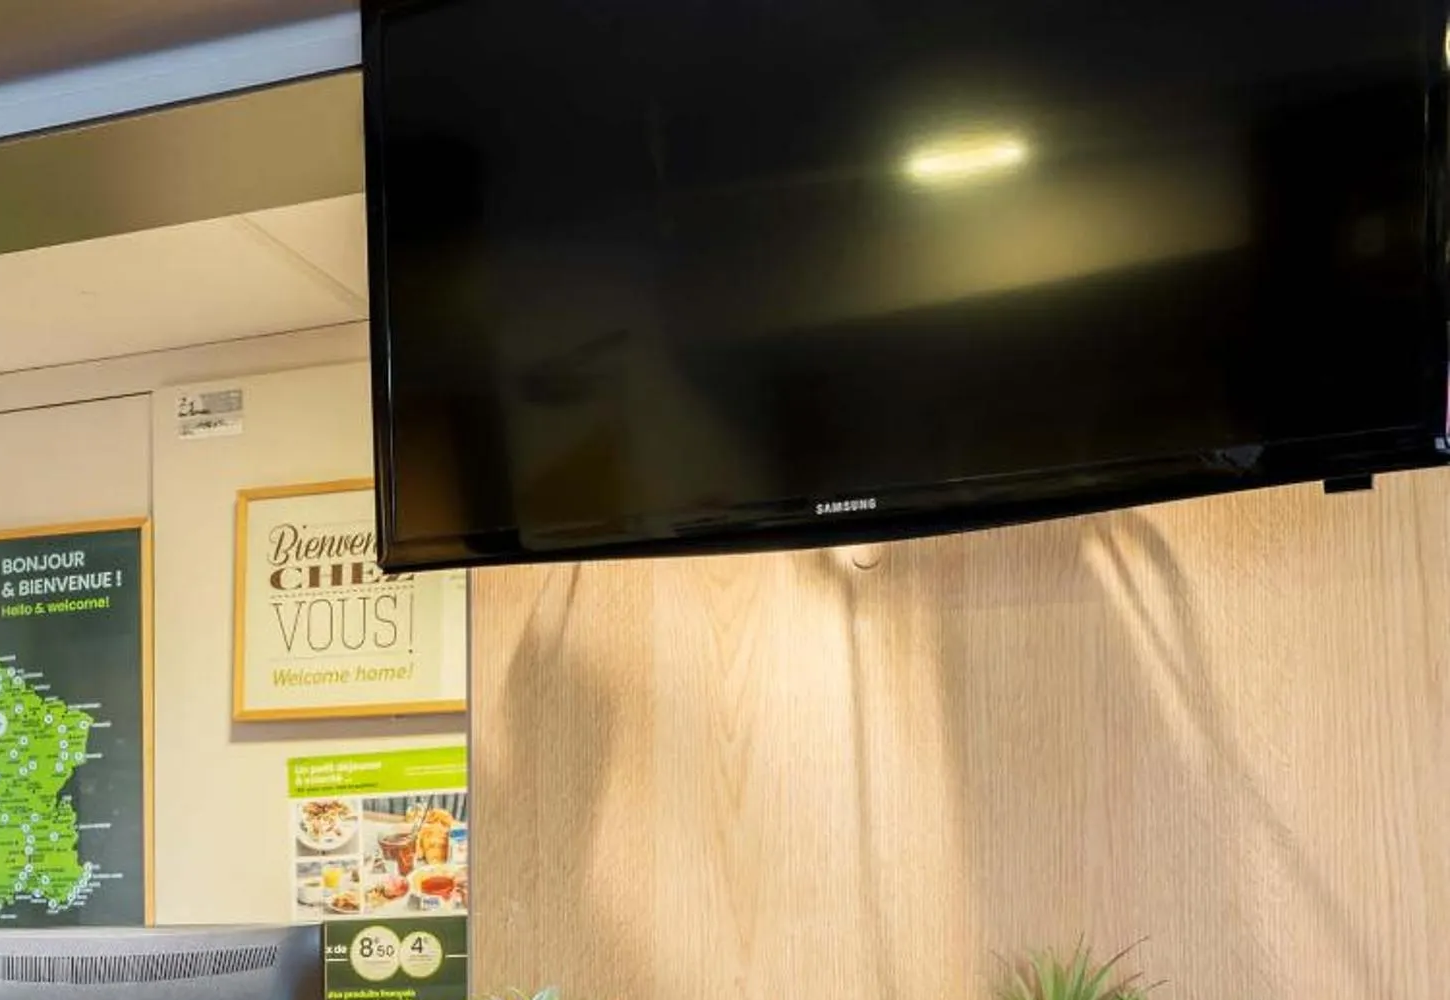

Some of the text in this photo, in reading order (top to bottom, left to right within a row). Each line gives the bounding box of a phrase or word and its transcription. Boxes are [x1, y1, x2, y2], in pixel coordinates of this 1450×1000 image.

[815, 498, 876, 515] SAMSUNG
[267, 523, 376, 566] Bienven
[1, 550, 85, 575] BONJOUR
[1, 581, 15, 598] &
[18, 572, 112, 596] BIENVENUE
[1, 596, 110, 618] Hello & welcome!
[272, 663, 414, 687] Welcome home!
